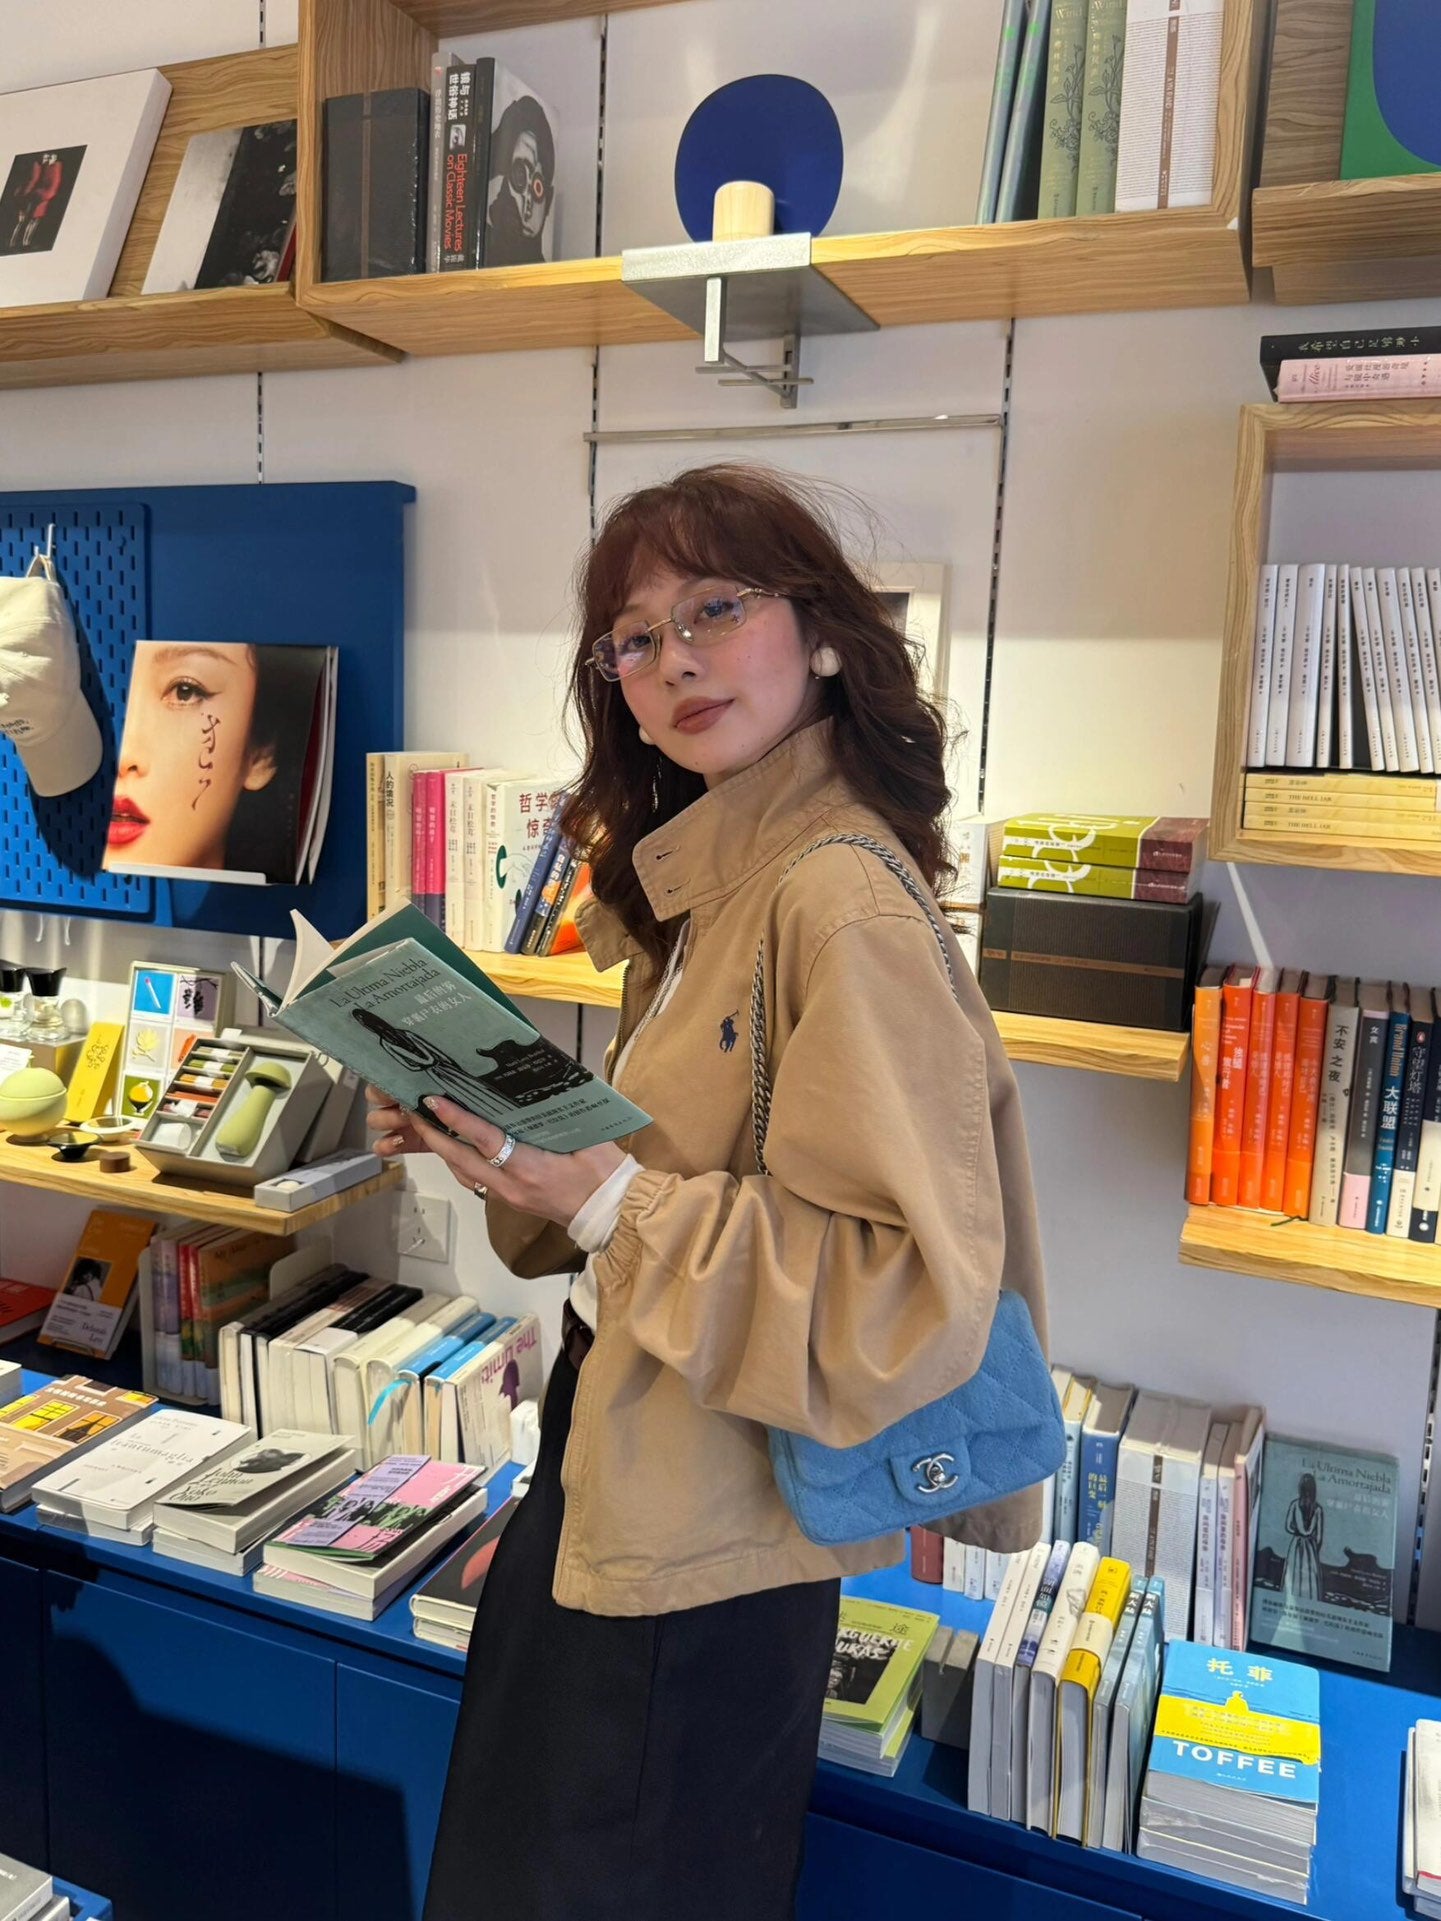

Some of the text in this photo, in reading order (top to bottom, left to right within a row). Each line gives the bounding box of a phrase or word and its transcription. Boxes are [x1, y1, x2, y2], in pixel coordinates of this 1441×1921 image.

[444, 155, 455, 249] on Classic Movies
[455, 153, 467, 251] Eighteen Lectures
[371, 968, 441, 1005] Amortajada
[386, 957, 428, 982] Niebla
[1328, 1025, 1349, 1083] 不安之夜
[1407, 1046, 1427, 1094] 守望灯塔
[1380, 1086, 1400, 1130] 大联盟
[1327, 1473, 1391, 1495] Amortajada
[1356, 1467, 1391, 1485] Niebla
[836, 1641, 892, 1660] URAS
[838, 1628, 914, 1649] RGUERITE
[1207, 1658, 1273, 1682] 托菲
[1172, 1740, 1297, 1779] TOFFEE
